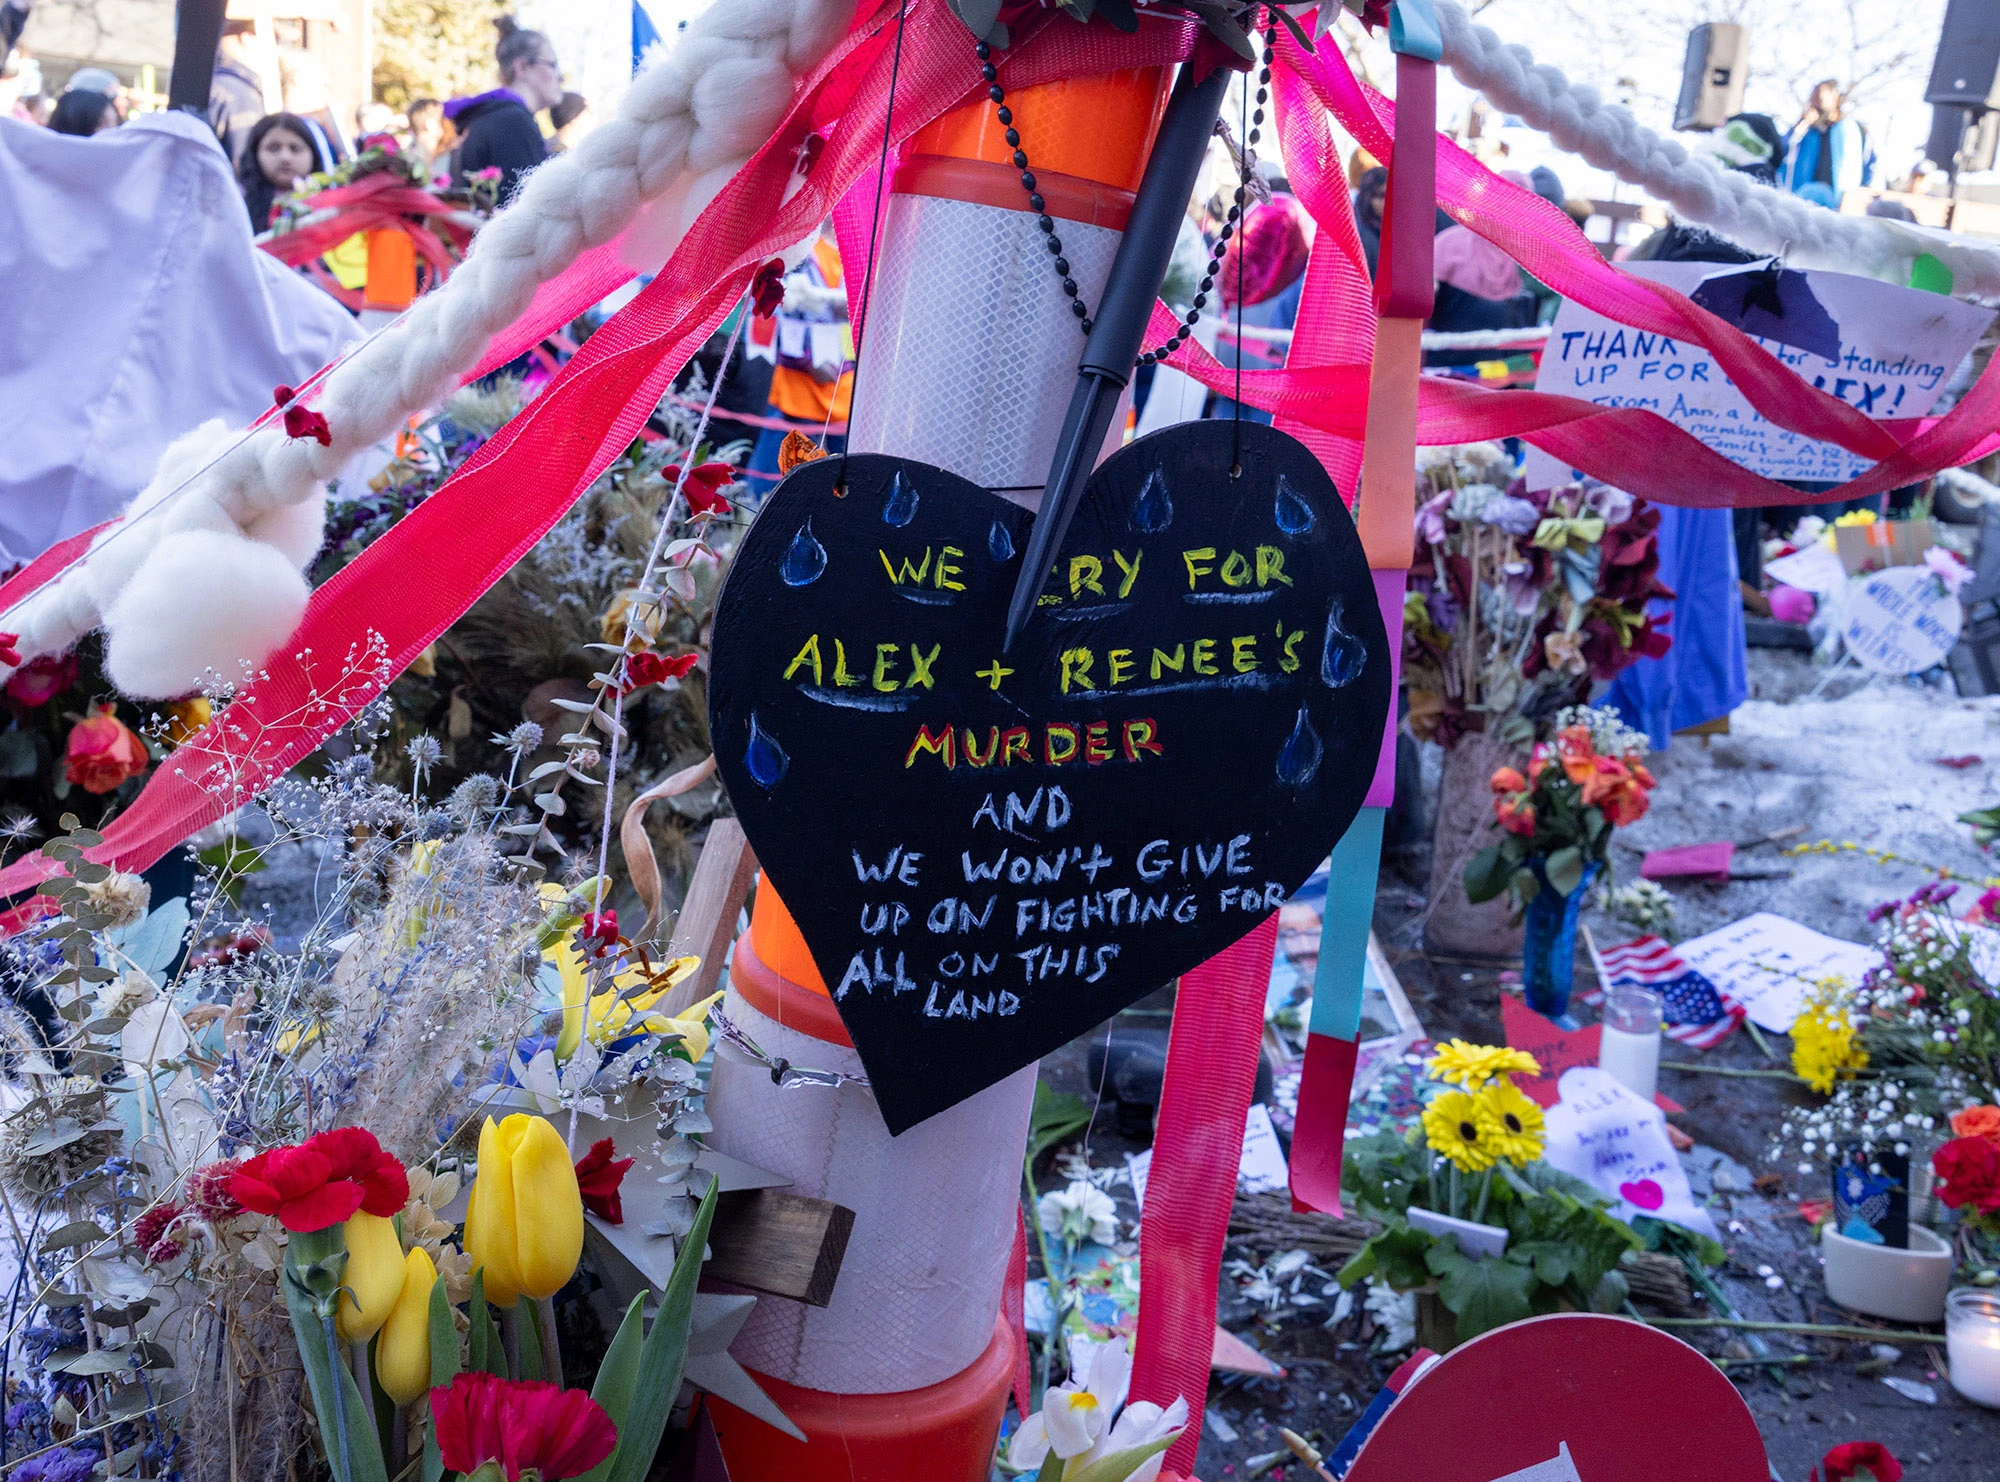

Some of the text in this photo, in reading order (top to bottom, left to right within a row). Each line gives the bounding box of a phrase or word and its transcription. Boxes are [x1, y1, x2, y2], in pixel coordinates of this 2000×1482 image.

[1561, 329, 1678, 362] THANK
[1575, 364, 1618, 387] UP
[1639, 360, 1709, 384] FOR
[1667, 392, 1720, 420] Ann,
[1726, 408, 1739, 420] a
[879, 544, 1293, 606] WE RY FOR
[783, 619, 1306, 694] ALEX + RENEE'S
[905, 718, 1165, 769] MURDER
[973, 785, 1071, 831] AND
[853, 845, 924, 887] WE
[1137, 834, 1252, 879] GIVE
[861, 882, 1287, 937] UP ON FIGHTING FOR
[836, 944, 1121, 1000] ALL ON THIS
[923, 980, 1021, 1020] LAND
